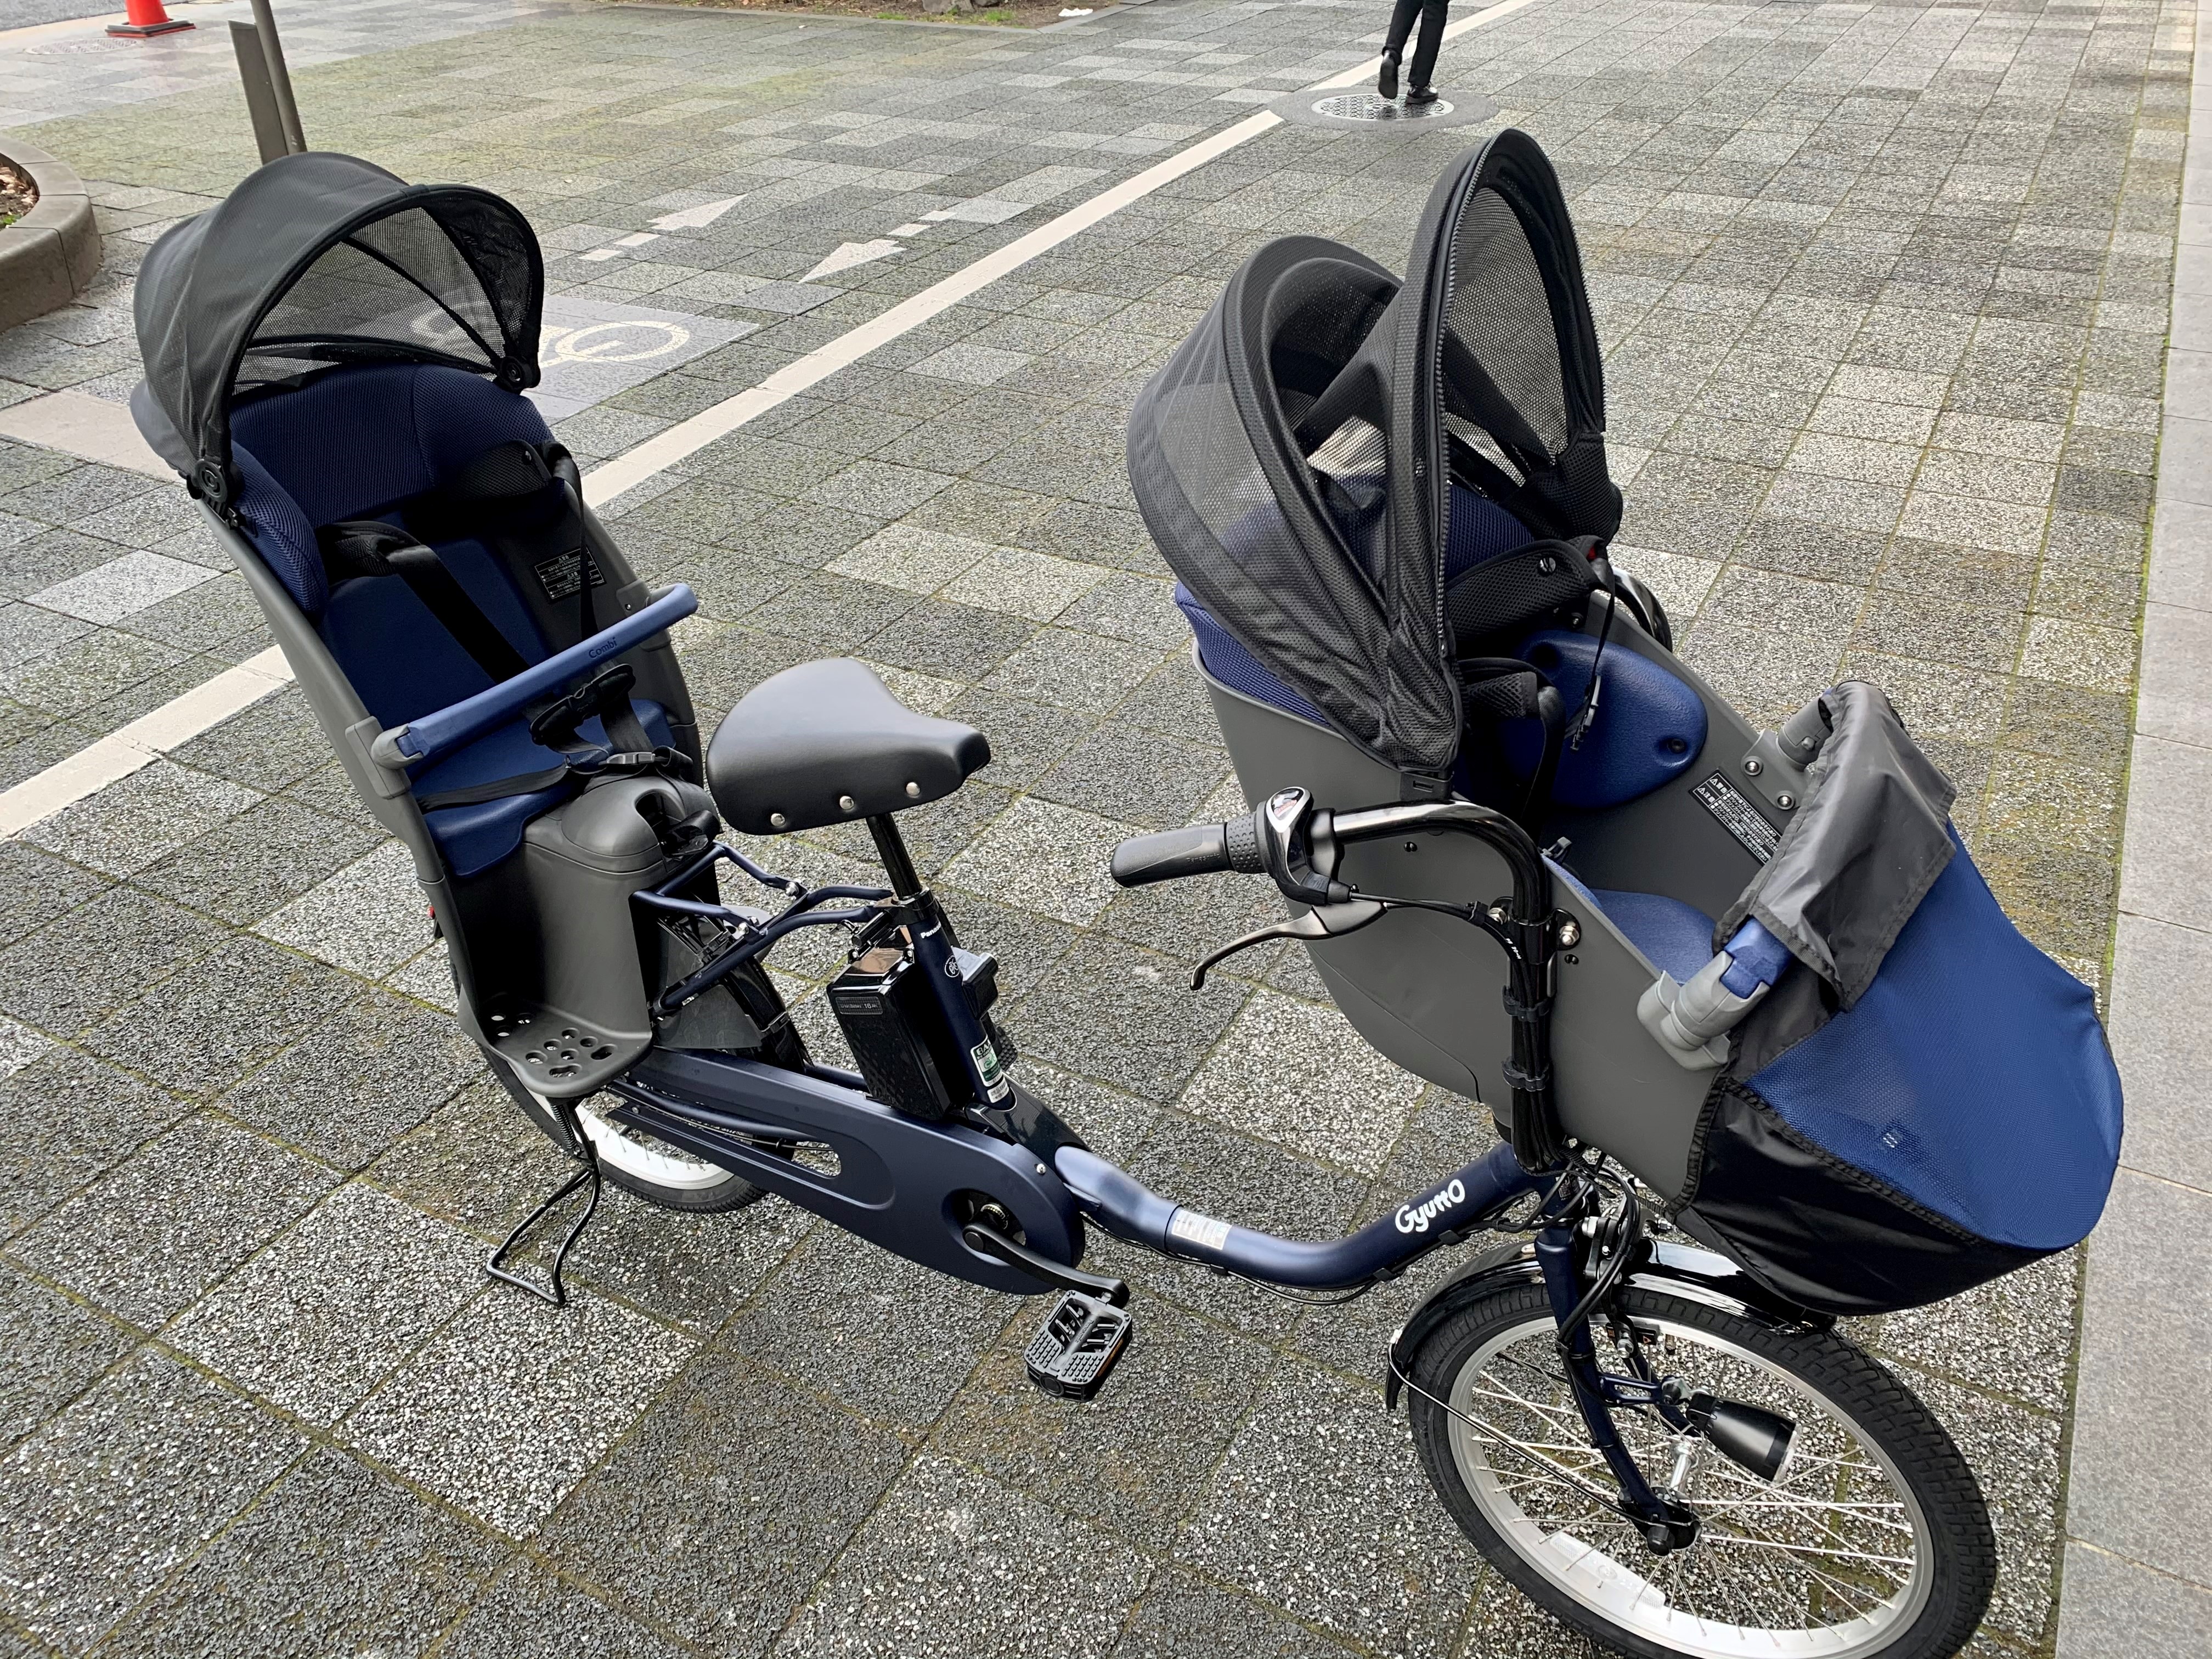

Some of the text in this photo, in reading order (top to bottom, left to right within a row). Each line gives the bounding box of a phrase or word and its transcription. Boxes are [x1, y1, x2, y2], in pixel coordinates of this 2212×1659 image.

[589, 637, 617, 658] Combi
[1716, 782, 1728, 794] 告
[1703, 792, 1716, 803] 注
